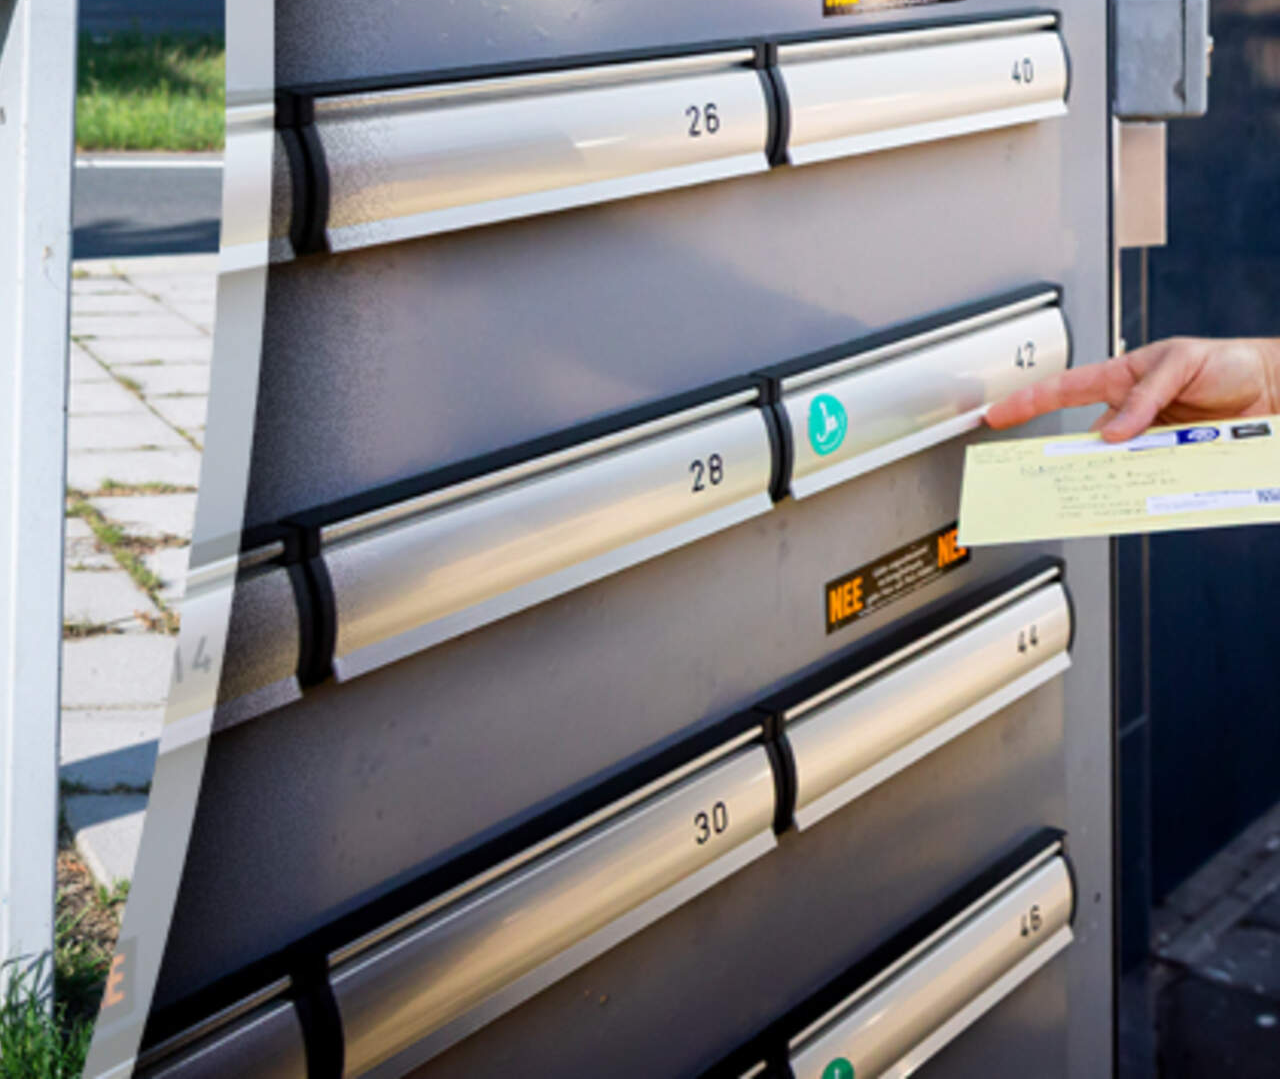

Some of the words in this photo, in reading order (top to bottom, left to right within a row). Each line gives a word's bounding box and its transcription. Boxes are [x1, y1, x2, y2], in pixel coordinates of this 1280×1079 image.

[1012, 56, 1035, 84] 40
[685, 102, 721, 138] 26
[1014, 340, 1036, 370] 42
[689, 453, 723, 494] 28
[828, 576, 864, 624] NEE
[1017, 624, 1039, 654] 44
[694, 801, 729, 846] 30
[1020, 904, 1042, 938] 46
